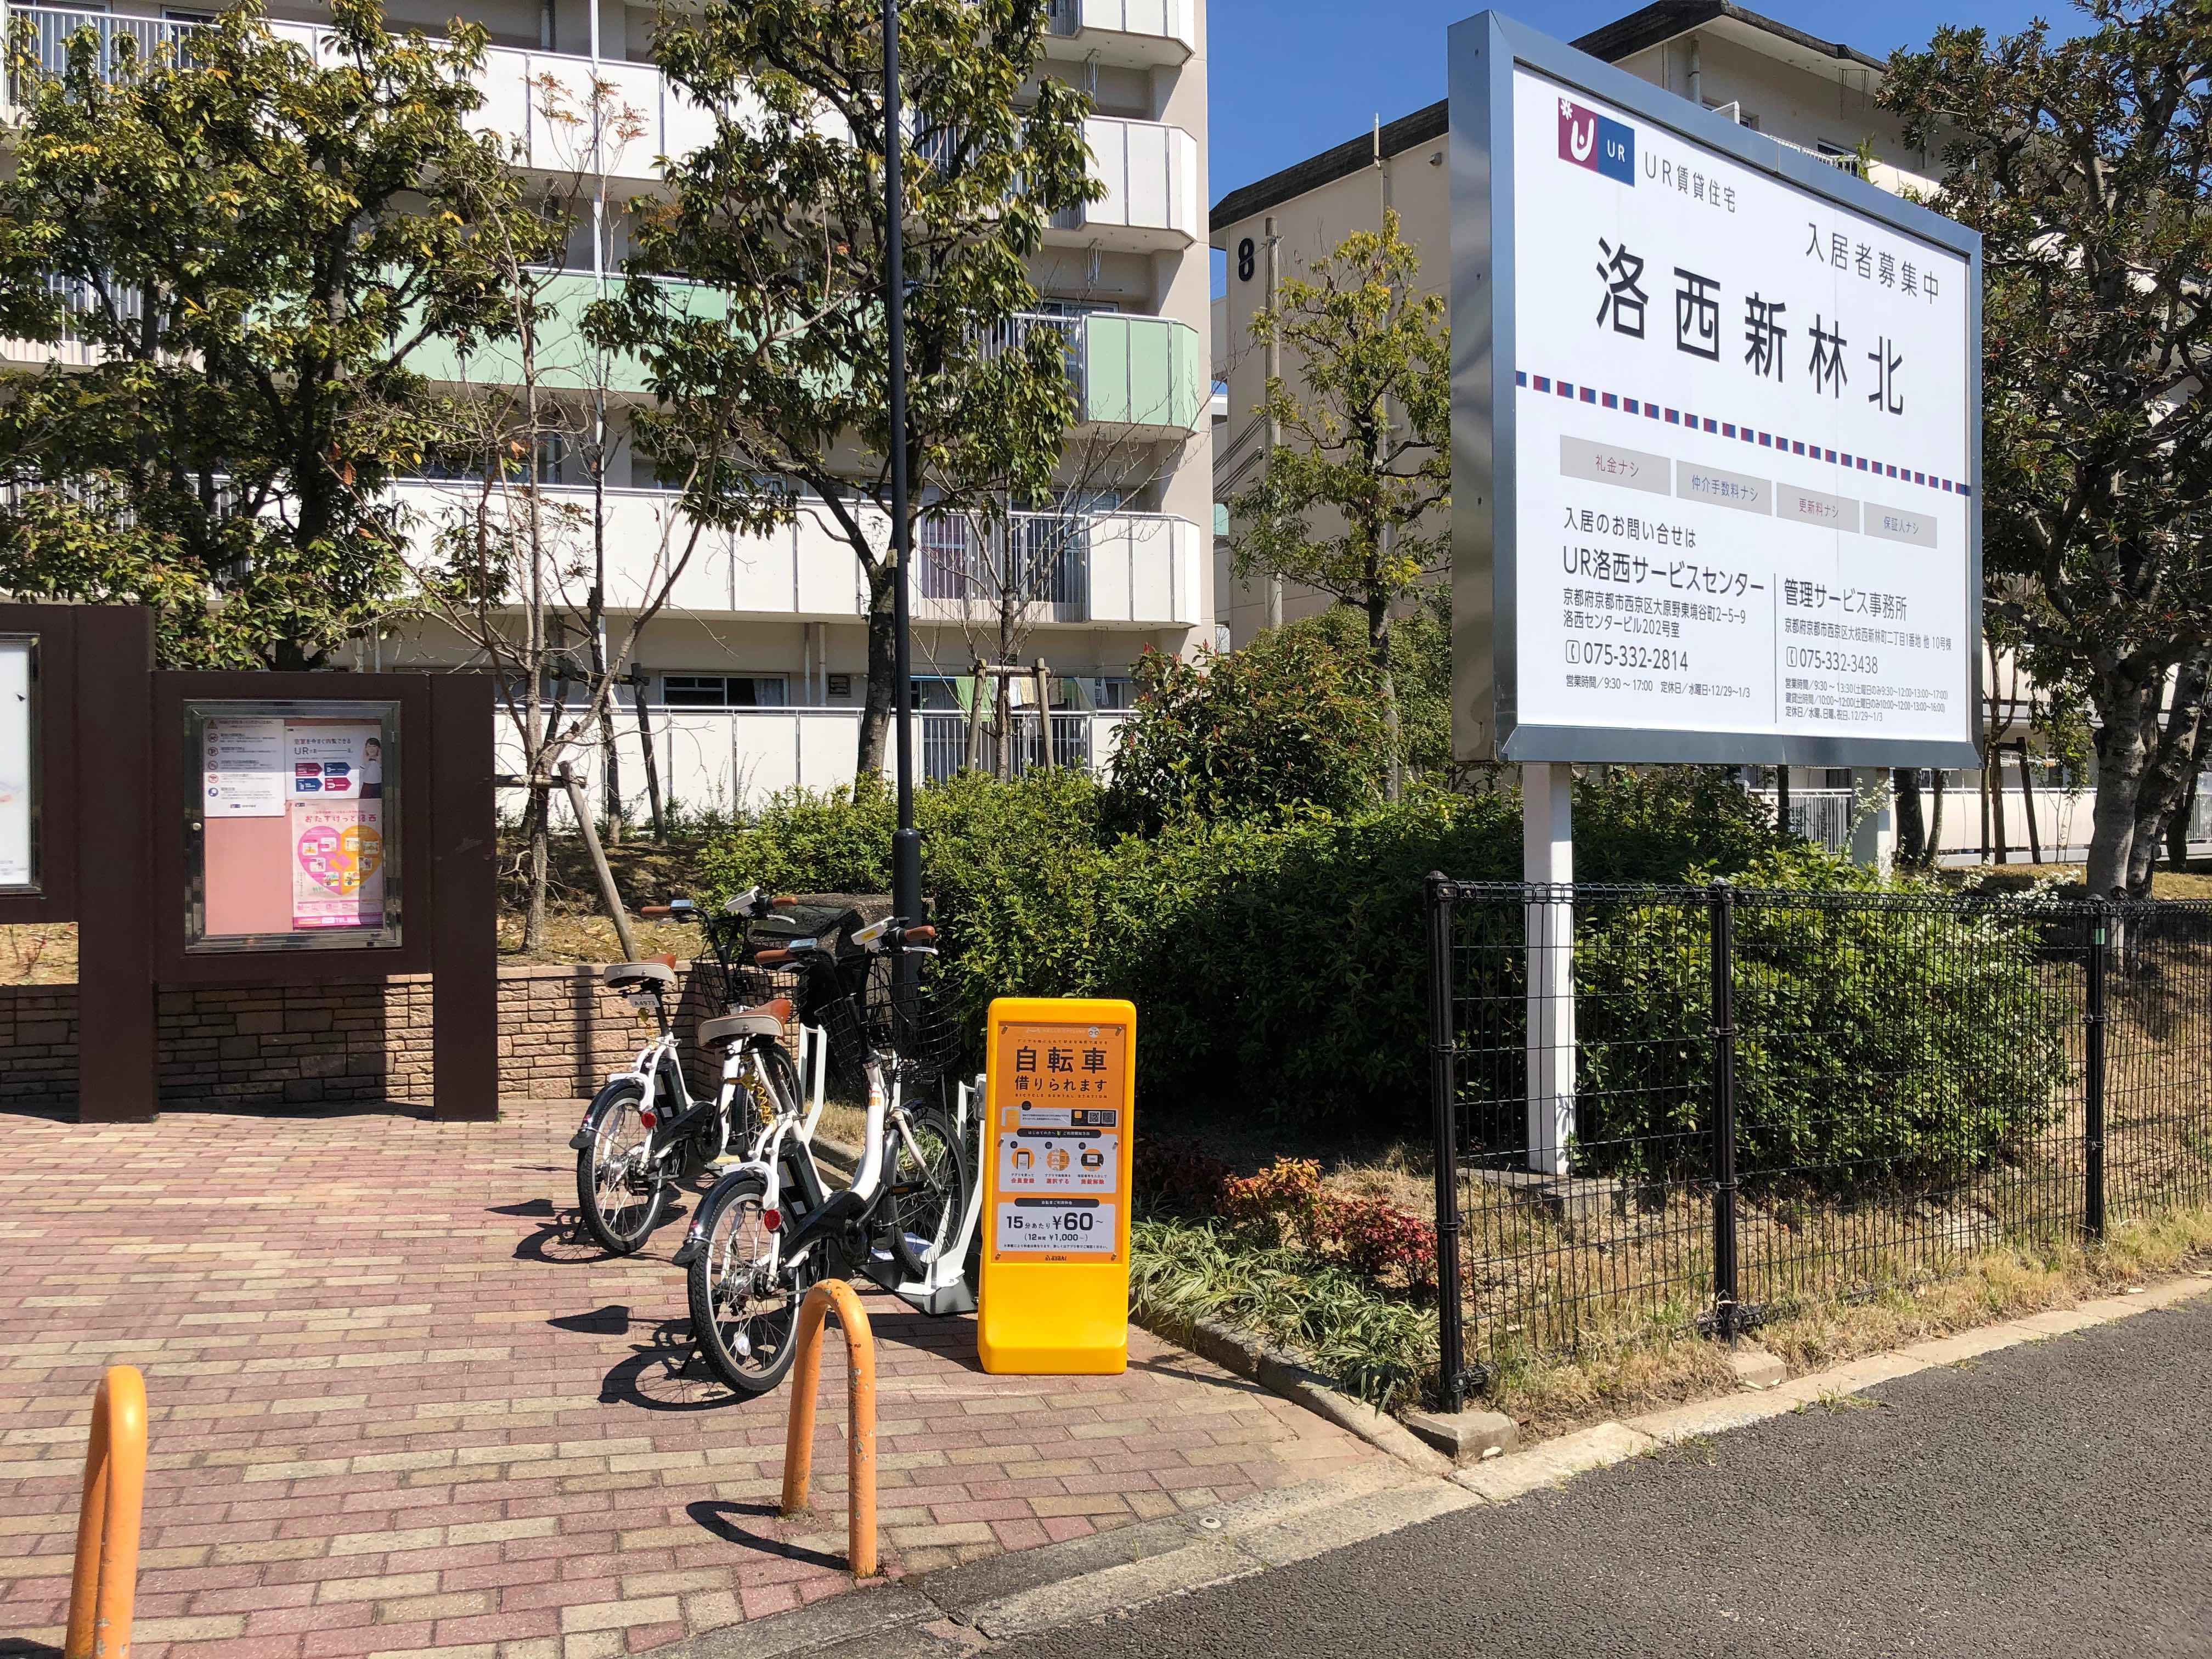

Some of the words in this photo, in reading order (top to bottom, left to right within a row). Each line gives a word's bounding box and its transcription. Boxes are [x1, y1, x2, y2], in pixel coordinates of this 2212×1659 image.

[1607, 138, 1625, 163] UR
[1645, 151, 1736, 213] UR賃貸住宅
[1238, 238, 1255, 281] 8
[1805, 222, 1939, 304] 入居者募集中
[1596, 236, 1904, 415] 洛西新林北
[1595, 454, 1639, 478] 礼金ナシ
[1691, 473, 1758, 502] 仲介手数料ナシ
[1798, 498, 1839, 518] 更新料ナシ
[1564, 506, 1696, 549] 入居のお問い合せは
[1883, 516, 1919, 534] 保証人ナシ
[1563, 545, 1764, 597] UR洛西サービスセンター
[1784, 577, 1908, 622] 管理サービス事務所
[1563, 609, 1680, 639] 洛西センタービル202号室
[1583, 641, 1689, 672] 075-332-2814
[1799, 648, 1878, 674] 075-332-3438
[1633, 679, 1654, 692] 17:00
[1015, 1045, 1108, 1074] 自転車
[1014, 1075, 1108, 1092] 借りられます
